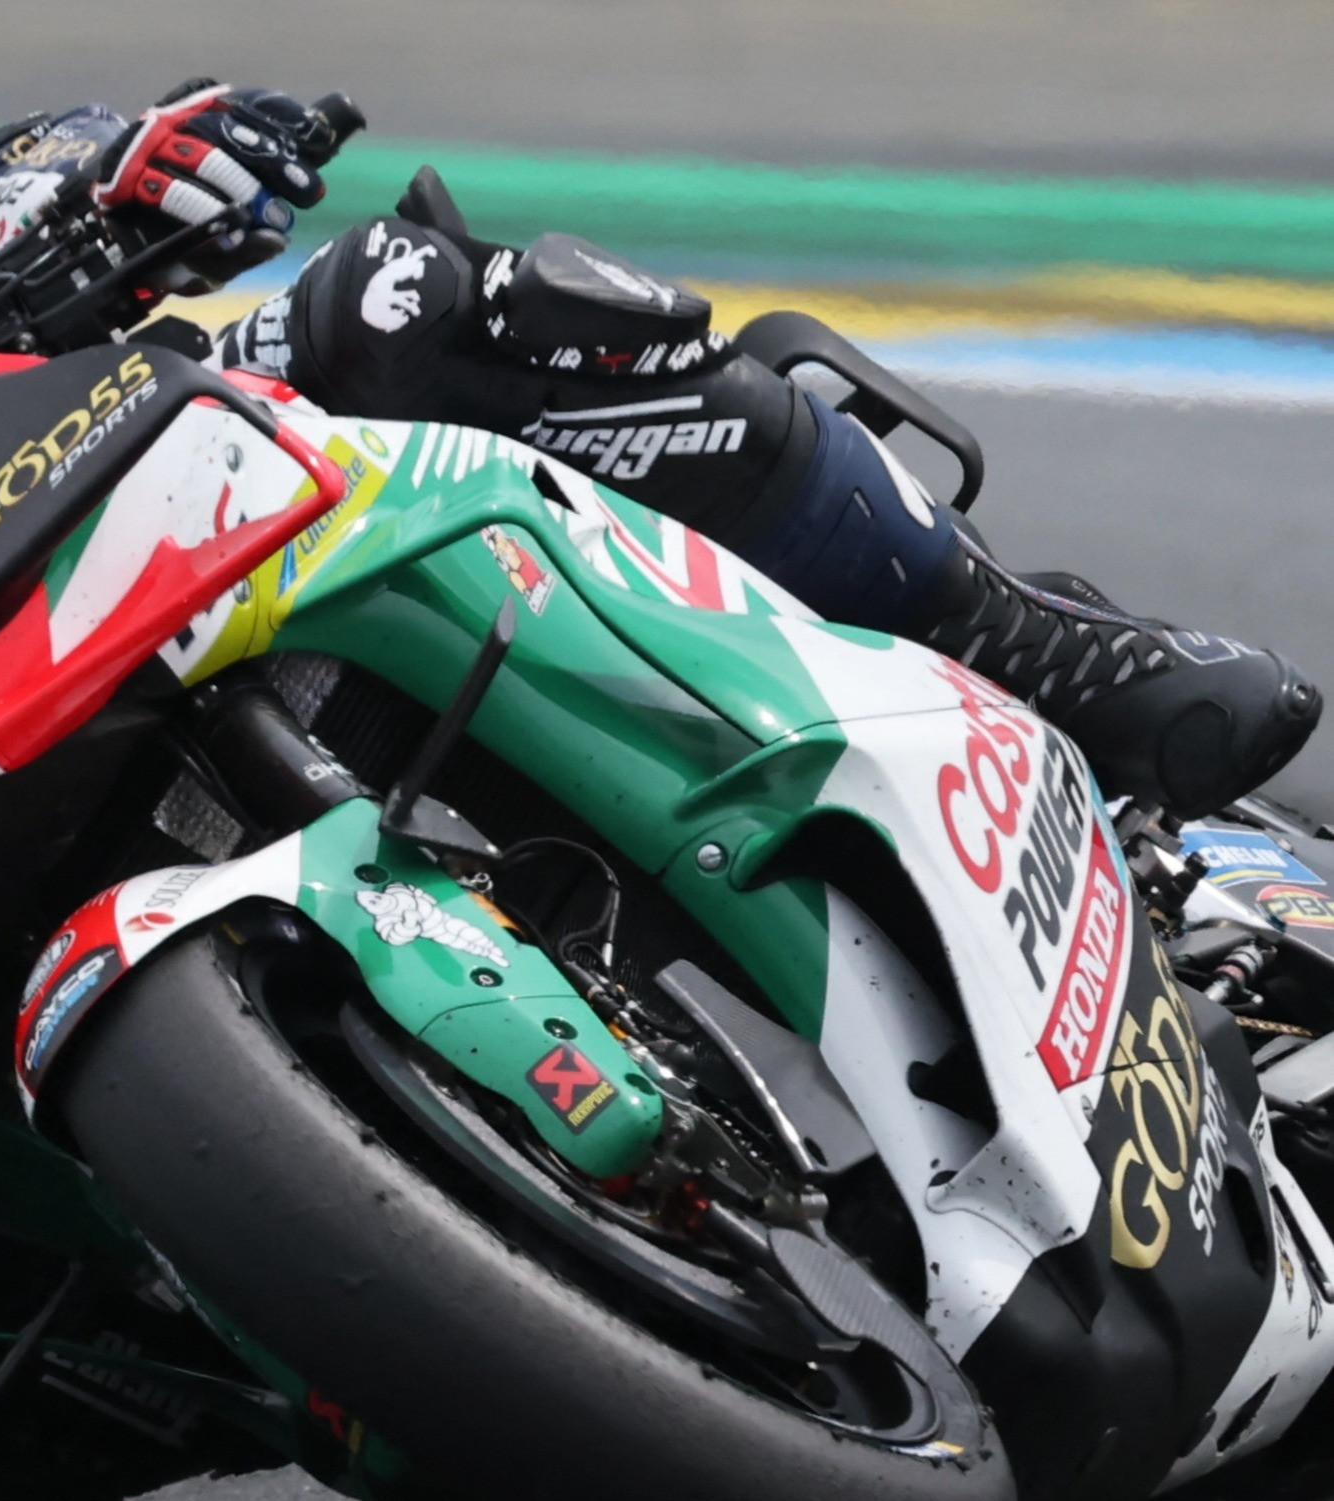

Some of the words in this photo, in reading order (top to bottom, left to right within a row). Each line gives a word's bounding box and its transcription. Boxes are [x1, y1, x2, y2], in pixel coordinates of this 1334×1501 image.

[50, 377, 158, 490] SPORTS
[25, 955, 105, 1070] DAYCO
[1051, 867, 1121, 1080] HONDA
